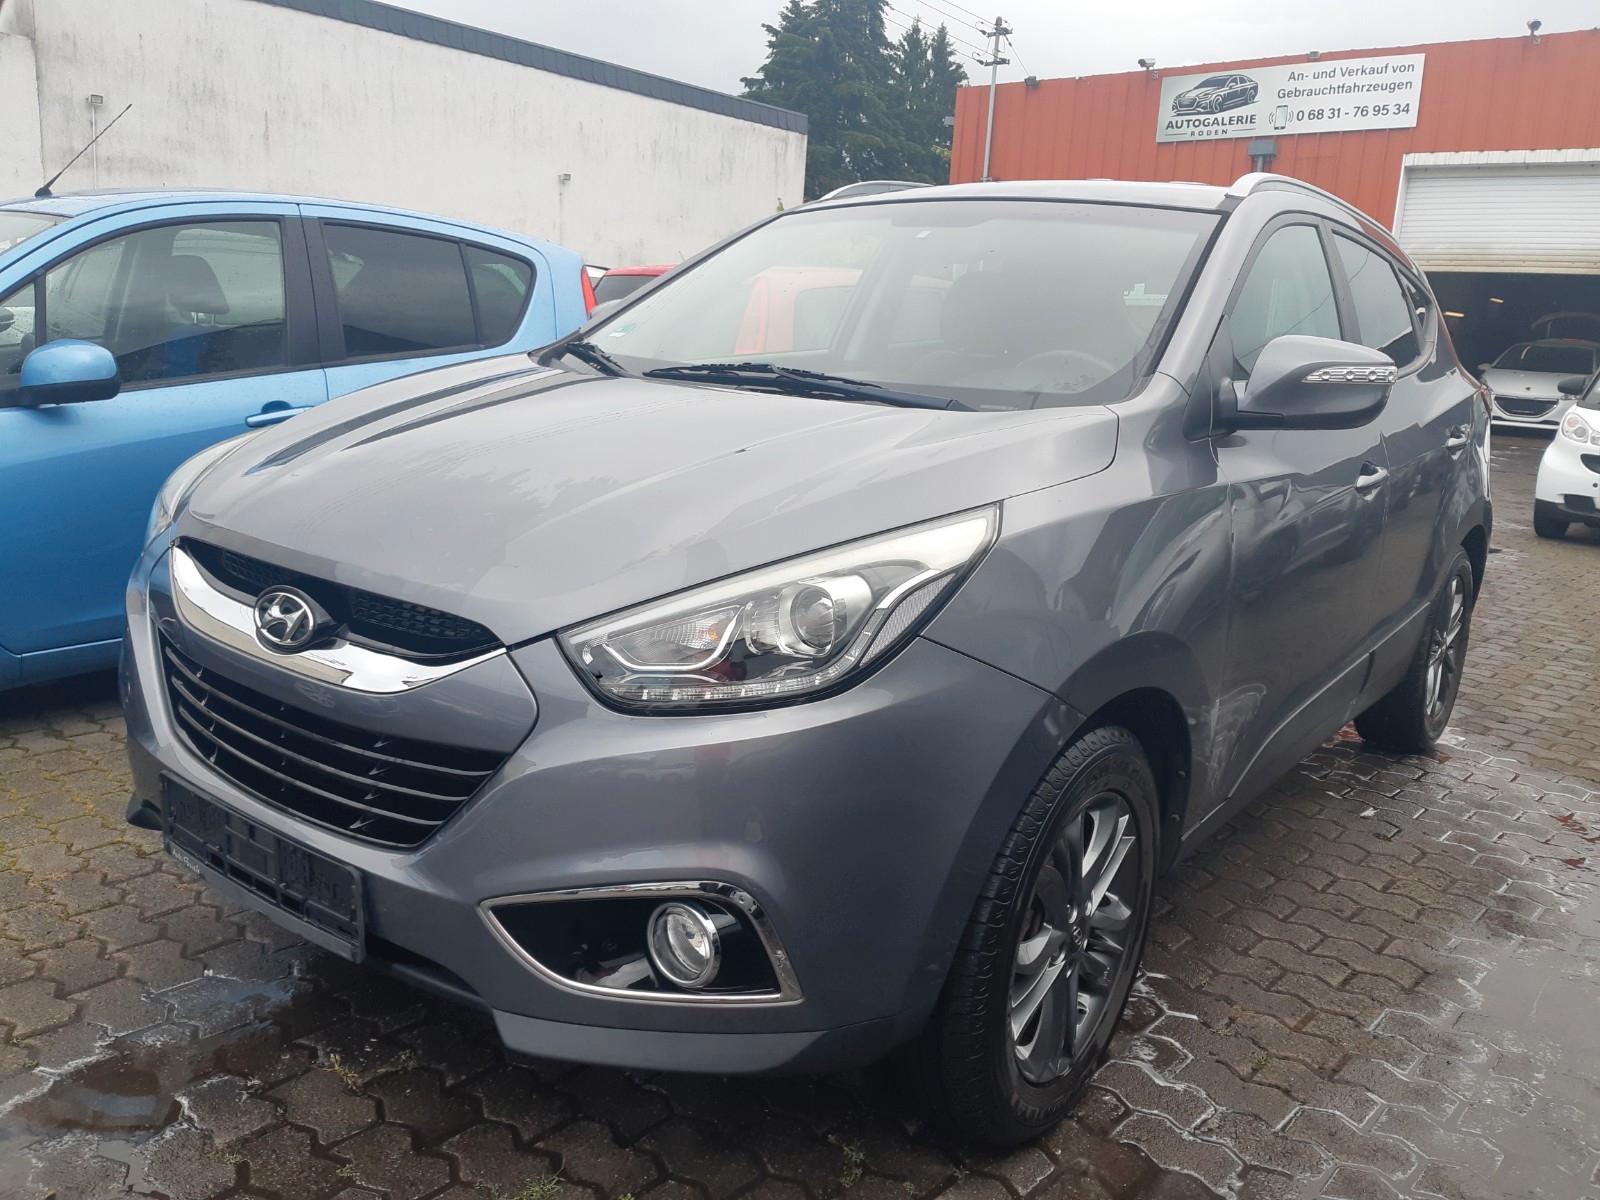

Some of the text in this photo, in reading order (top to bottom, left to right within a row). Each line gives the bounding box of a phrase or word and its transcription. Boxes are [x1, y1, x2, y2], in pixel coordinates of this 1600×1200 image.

[1287, 62, 1415, 82] An- und Verkauf von
[1277, 80, 1413, 99] Gebrauchtfahrzeugen
[1165, 114, 1257, 130] AUTOGALERIE
[1296, 110, 1305, 122] 0
[1307, 108, 1325, 121] 68
[1327, 107, 1342, 120] 31
[1353, 105, 1369, 118] 76
[1372, 104, 1391, 117] 95
[1392, 103, 1411, 116] 34
[1190, 128, 1229, 137] RODEN
